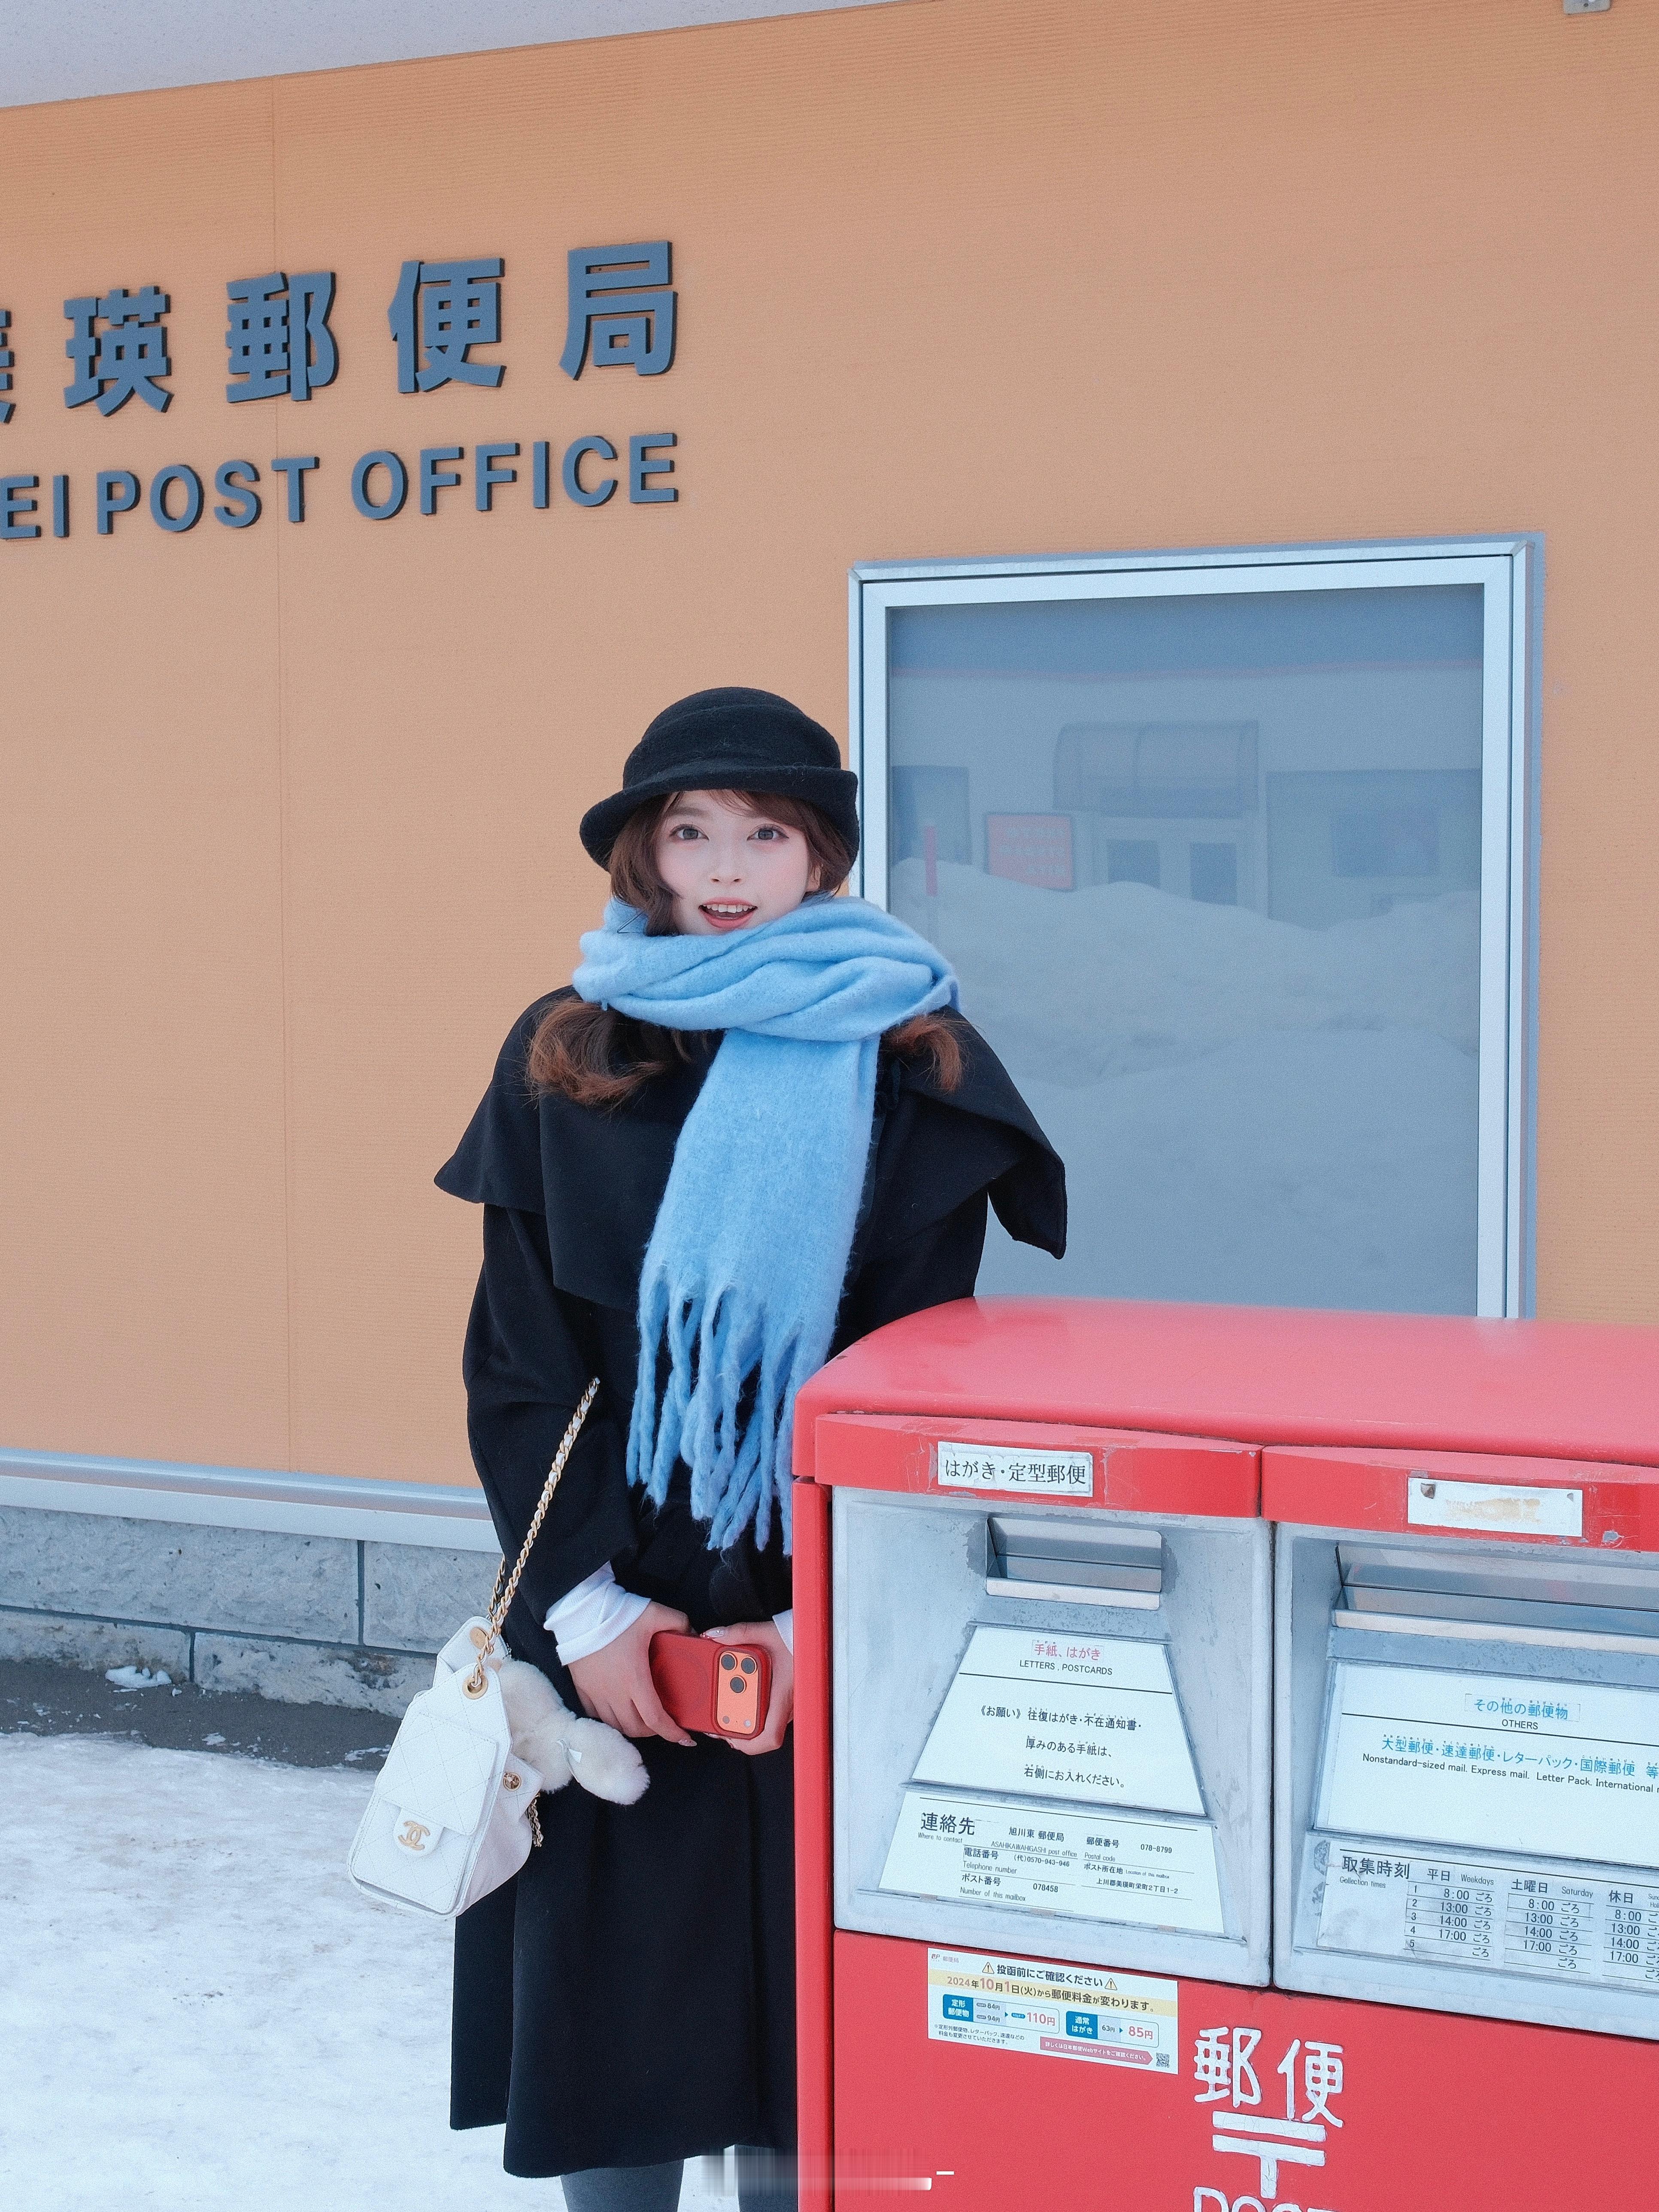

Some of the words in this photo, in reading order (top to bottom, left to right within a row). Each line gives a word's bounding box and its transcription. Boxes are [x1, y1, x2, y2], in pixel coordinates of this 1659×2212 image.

[0, 240, 679, 424] 瑛郵便局
[0, 475, 70, 539] EI
[97, 456, 320, 535] POST
[350, 433, 679, 521] OFFICE
[945, 1459, 1086, 1484] はがき・定型郵便
[1034, 1644, 1101, 1661] 手紙、はがき
[1062, 1663, 1113, 1675] POSTCARDS
[1474, 1699, 1568, 1720] その他の郵便物
[1502, 1719, 1538, 1730] OTHERS
[1025, 1738, 1112, 1757] 厚みのある手紙は、
[1024, 1766, 1124, 1788] 右側にお入れください。
[1363, 1753, 1445, 1770] Nonstandard-sized
[1471, 1765, 1507, 1777] Express
[1536, 1771, 1565, 1783] Letter
[1596, 1778, 1653, 1793] International
[1646, 1765, 1659, 1779] 等
[920, 1812, 975, 1835] 連絡先
[1038, 1830, 1064, 1842] 郵便局
[1086, 1836, 1119, 1848] 郵便番号
[1140, 1844, 1172, 1854] 078-8799
[964, 1847, 999, 1860] 電話番号
[1084, 1852, 1101, 1860] Postal
[963, 1860, 992, 1871] Telephone
[995, 1866, 1018, 1874] number
[1084, 1863, 1123, 1875] ポスト所在地
[1341, 1856, 1410, 1879] 取集時刻
[1427, 1868, 1450, 1881] 平日
[961, 1873, 1001, 1886] ポスト番号
[1340, 1876, 1368, 1886] Collection
[1461, 1874, 1494, 1886] Weekdays
[1511, 1878, 1548, 1893] 土曜日
[960, 1887, 982, 1896] Number
[1414, 1885, 1417, 1893] 1
[1444, 1888, 1469, 1900] 8:00
[1475, 1892, 1492, 1903] ごろ
[1562, 1886, 1593, 1899] Saturday
[1608, 1890, 1633, 1904] 休日
[1412, 1899, 1417, 1907] 2
[1441, 1902, 1468, 1914] 13:00
[1475, 1906, 1492, 1917] ごろ
[1528, 1899, 1555, 1911] 8:00
[1561, 1902, 1580, 1914] ごろ
[1440, 1915, 1467, 1927] 14:00
[1474, 1920, 1491, 1930] ごろ
[1525, 1912, 1553, 1925] 13:00
[1560, 1916, 1579, 1928] ごろ
[1615, 1909, 1641, 1921] 8:00
[1648, 1913, 1659, 1923] ご
[1410, 1926, 1416, 1934] 4
[1439, 1929, 1467, 1941] 17:00
[1473, 1933, 1490, 1944] ごろ
[1524, 1926, 1553, 1939] 14:00
[1559, 1930, 1578, 1942] ごろ
[1611, 1923, 1640, 1936] 13:00
[1647, 1927, 1659, 1937] ご
[1410, 1939, 1415, 1948] 5
[1472, 1947, 1489, 1957] ごろ
[1523, 1940, 1552, 1952] 17:00
[1559, 1944, 1577, 1956] ごろ
[1611, 1937, 1639, 1950] 14:00
[1647, 1941, 1659, 1951] ご
[1558, 1958, 1577, 1969] ごろ
[1610, 1951, 1638, 1963] 17:00
[1646, 1955, 1659, 1965] ご
[997, 1964, 1103, 1987] 投函前にご確認ください
[1645, 1969, 1659, 1981] ご
[1027, 2012, 1055, 2027] 110円
[1071, 2025, 1093, 2035] はがき
[1128, 2026, 1153, 2040] 85円
[1193, 2026, 1344, 2128] 郵便
